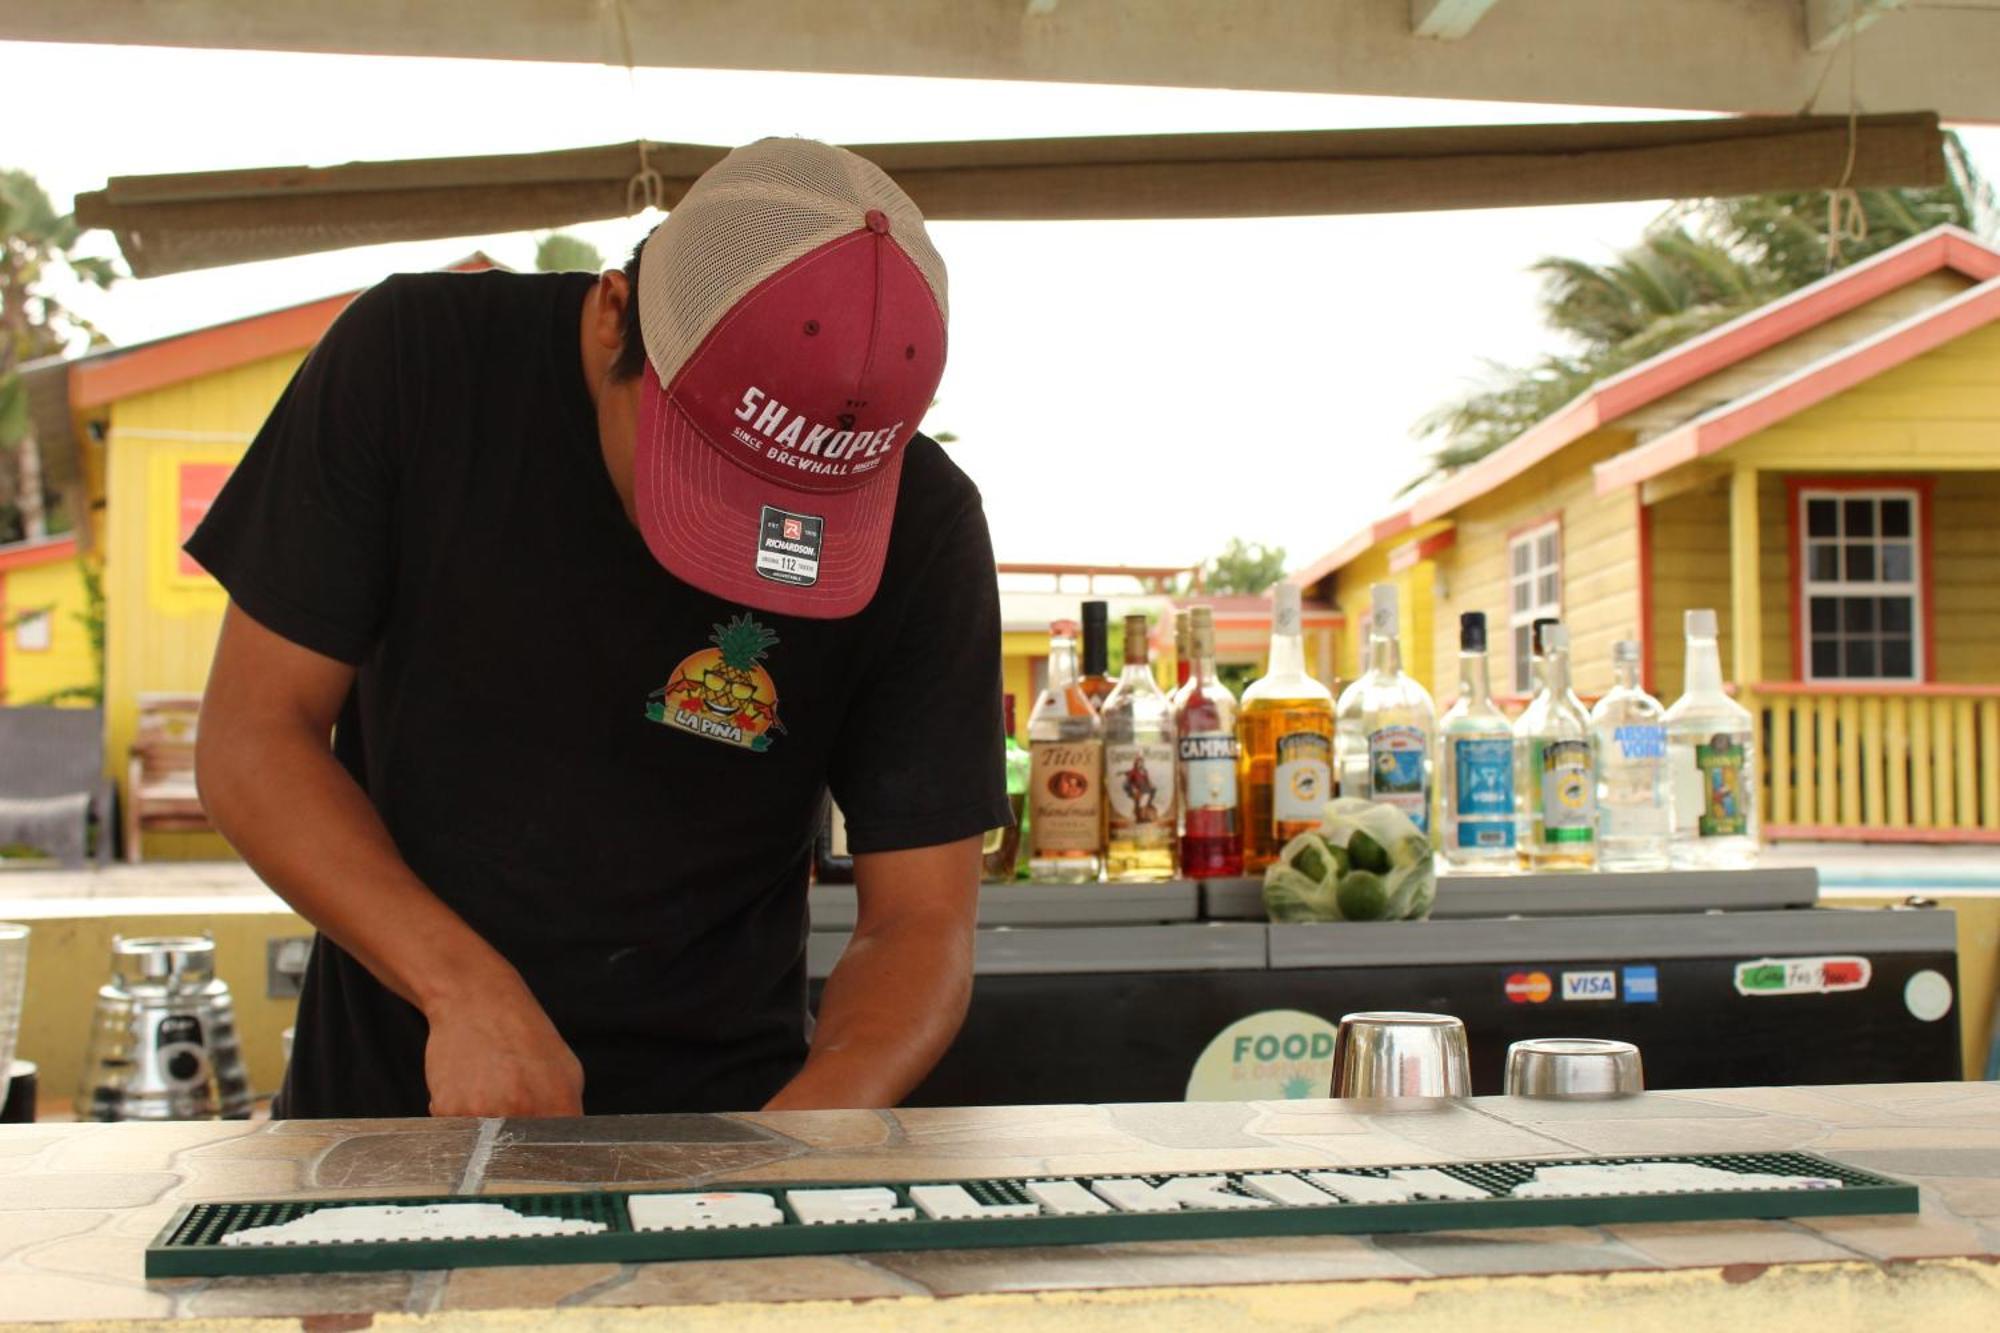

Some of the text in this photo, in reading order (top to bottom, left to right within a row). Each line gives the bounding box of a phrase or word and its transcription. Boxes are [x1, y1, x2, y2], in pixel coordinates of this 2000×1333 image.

[735, 386, 904, 460] SHAKOPEE
[732, 428, 764, 449] SINCE
[767, 447, 848, 475] BREWHALL
[765, 538, 814, 556] RICHARDSON
[782, 557, 797, 571] 112
[676, 711, 698, 729] LA
[1568, 978, 1613, 994] VISA
[1233, 1033, 1334, 1063] FOOD
